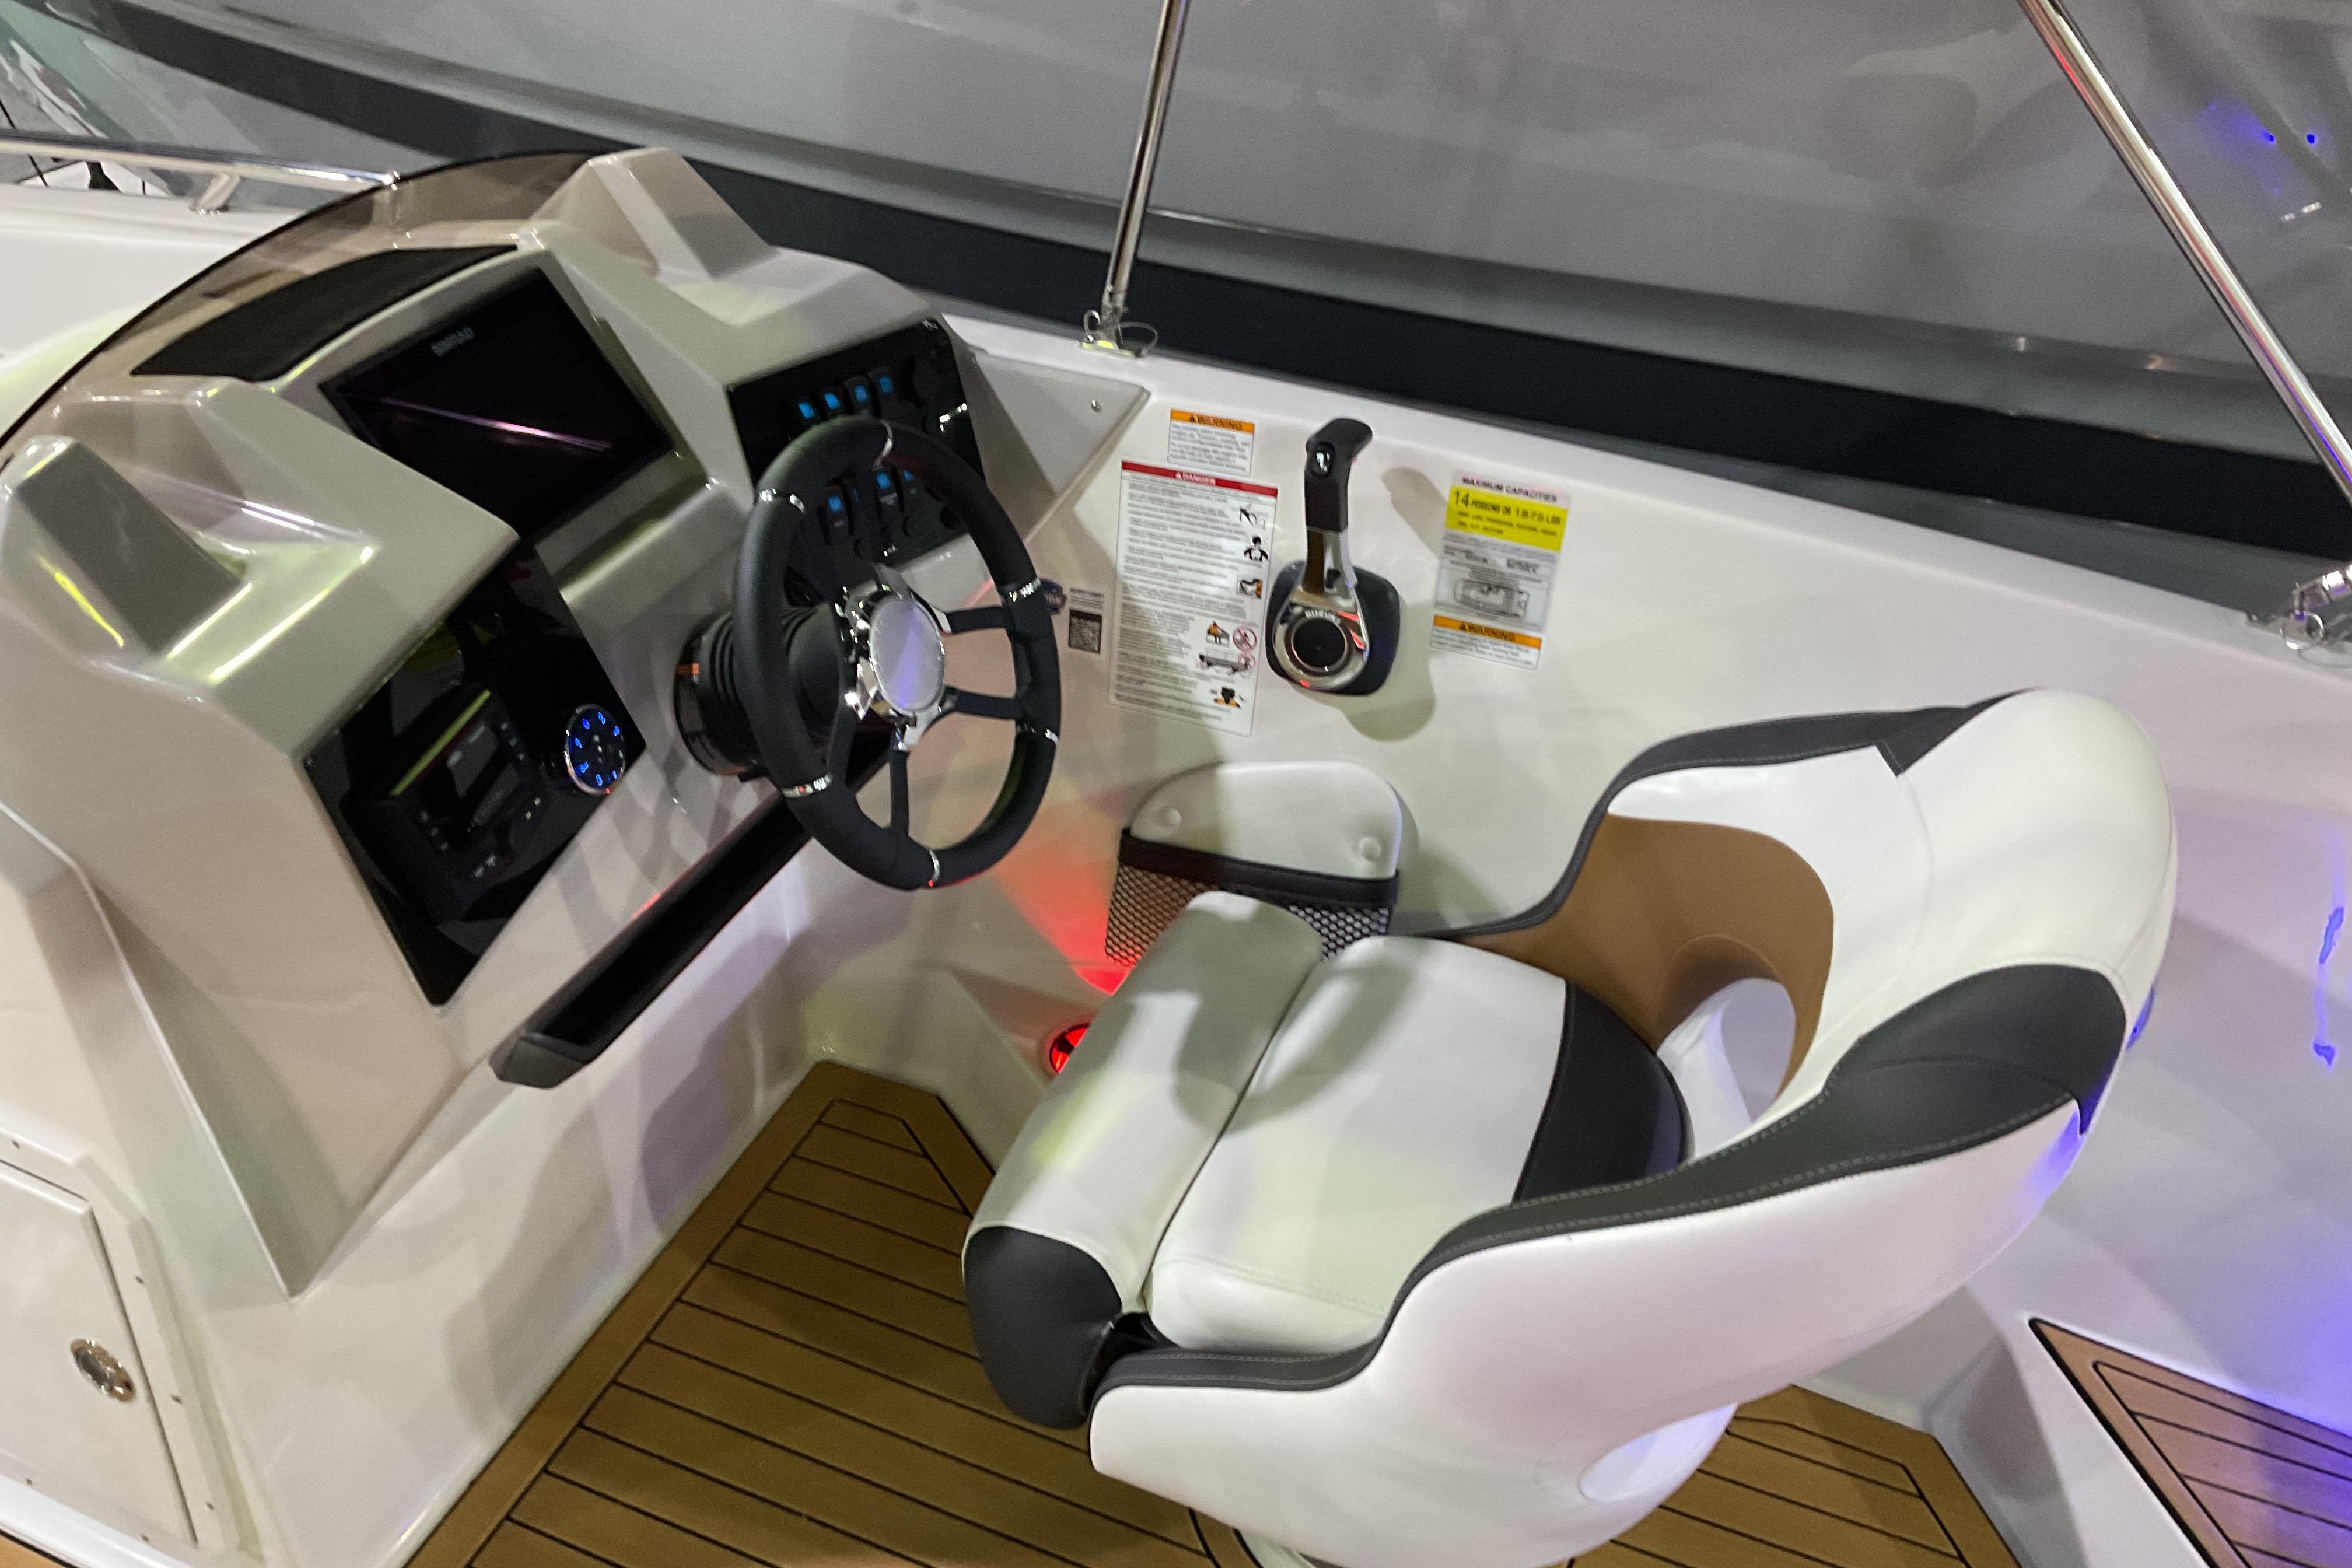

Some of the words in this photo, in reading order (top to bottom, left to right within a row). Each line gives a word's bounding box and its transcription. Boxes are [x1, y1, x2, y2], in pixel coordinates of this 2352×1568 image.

[1196, 415, 1242, 430] WARNING
[1183, 471, 1216, 485] DANGER
[1462, 477, 1503, 491] MAXIMUM
[1505, 485, 1556, 502] CAPACITIES
[1455, 490, 1469, 507] 14
[1466, 623, 1516, 642] WARNING
